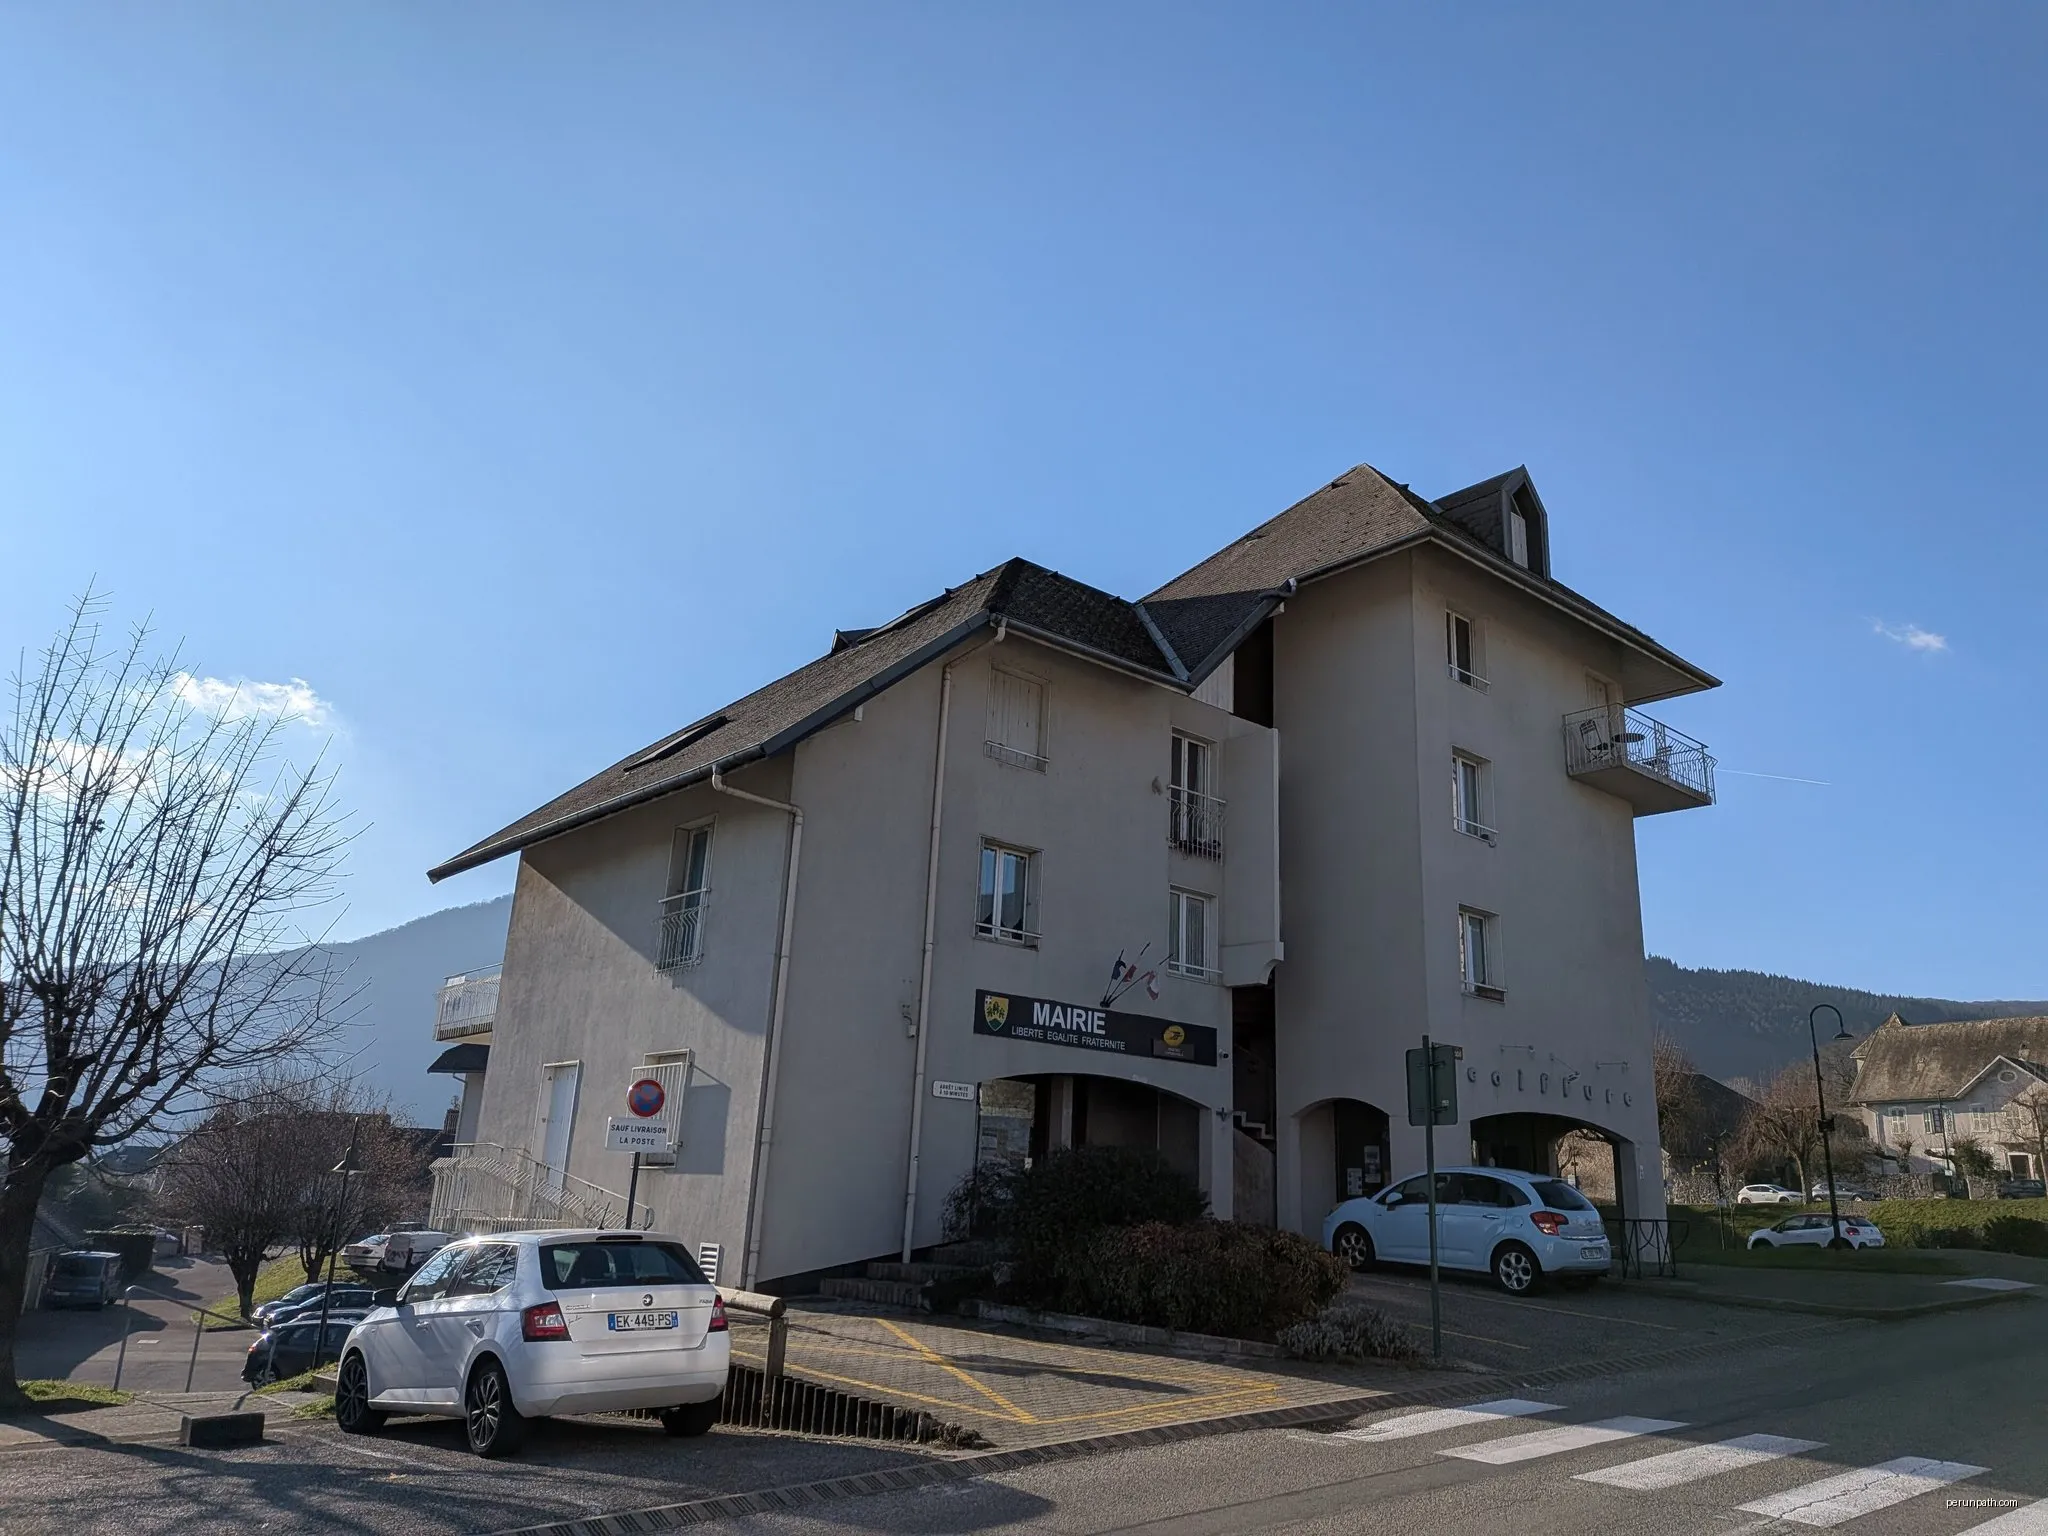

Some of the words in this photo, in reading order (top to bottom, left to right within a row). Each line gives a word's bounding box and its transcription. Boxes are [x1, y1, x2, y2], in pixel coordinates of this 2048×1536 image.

[1033, 1002, 1106, 1035] MAIRIE
[1011, 1025, 1044, 1039] LIBERTE
[1047, 1030, 1078, 1044] EGALITE
[1082, 1035, 1126, 1050] FRATERNITE
[610, 1124, 630, 1132] SAUF
[630, 1126, 667, 1134] LIVRAISON
[619, 1136, 629, 1144] LA
[630, 1137, 656, 1146] POSTE
